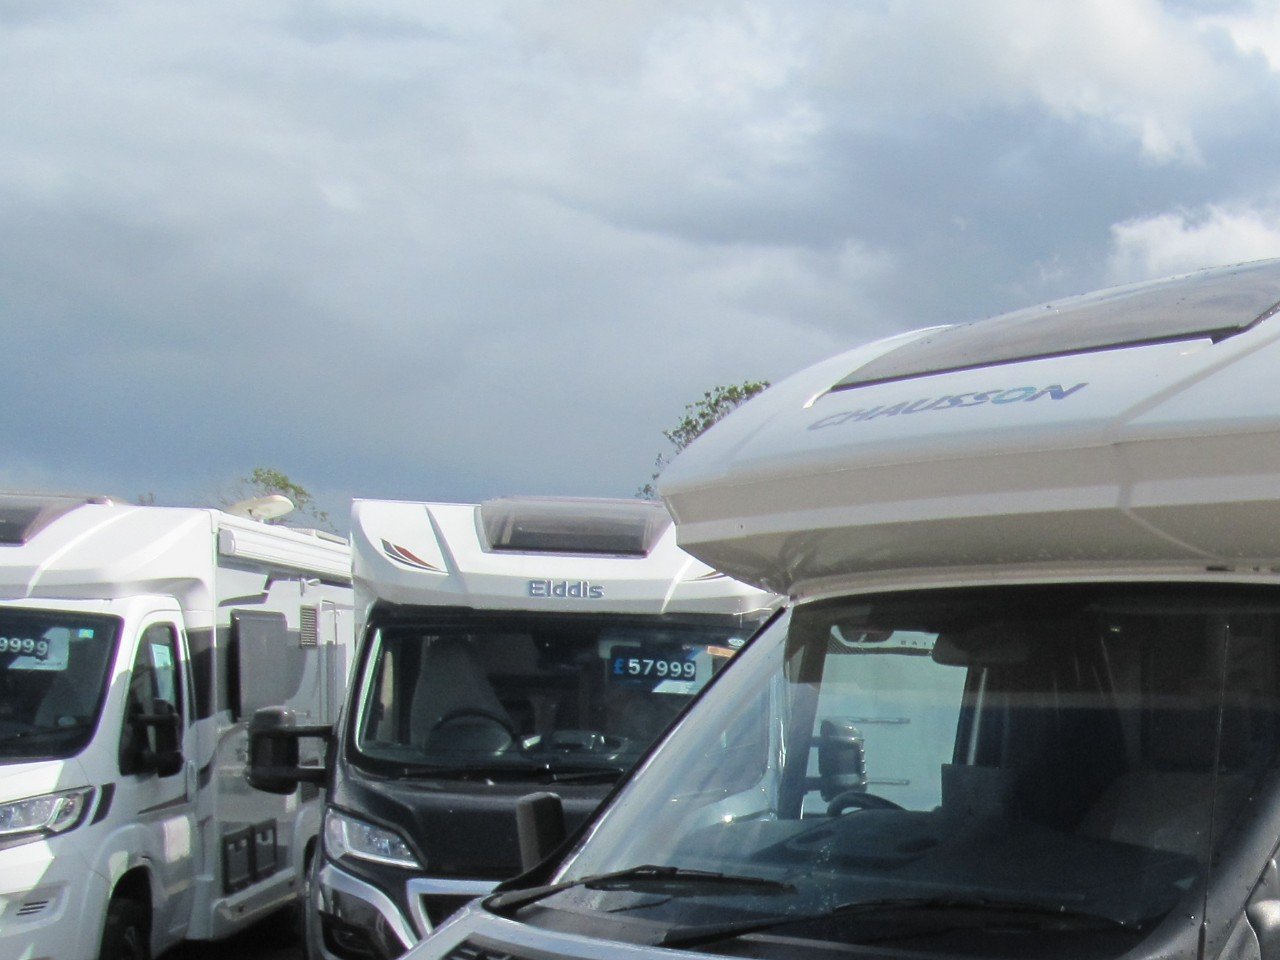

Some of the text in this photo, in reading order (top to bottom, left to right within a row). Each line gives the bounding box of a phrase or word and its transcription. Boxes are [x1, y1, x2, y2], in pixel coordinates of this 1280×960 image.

[807, 382, 1090, 432] CHAUSSON
[528, 579, 605, 598] Elddis
[613, 658, 696, 677] £57999
